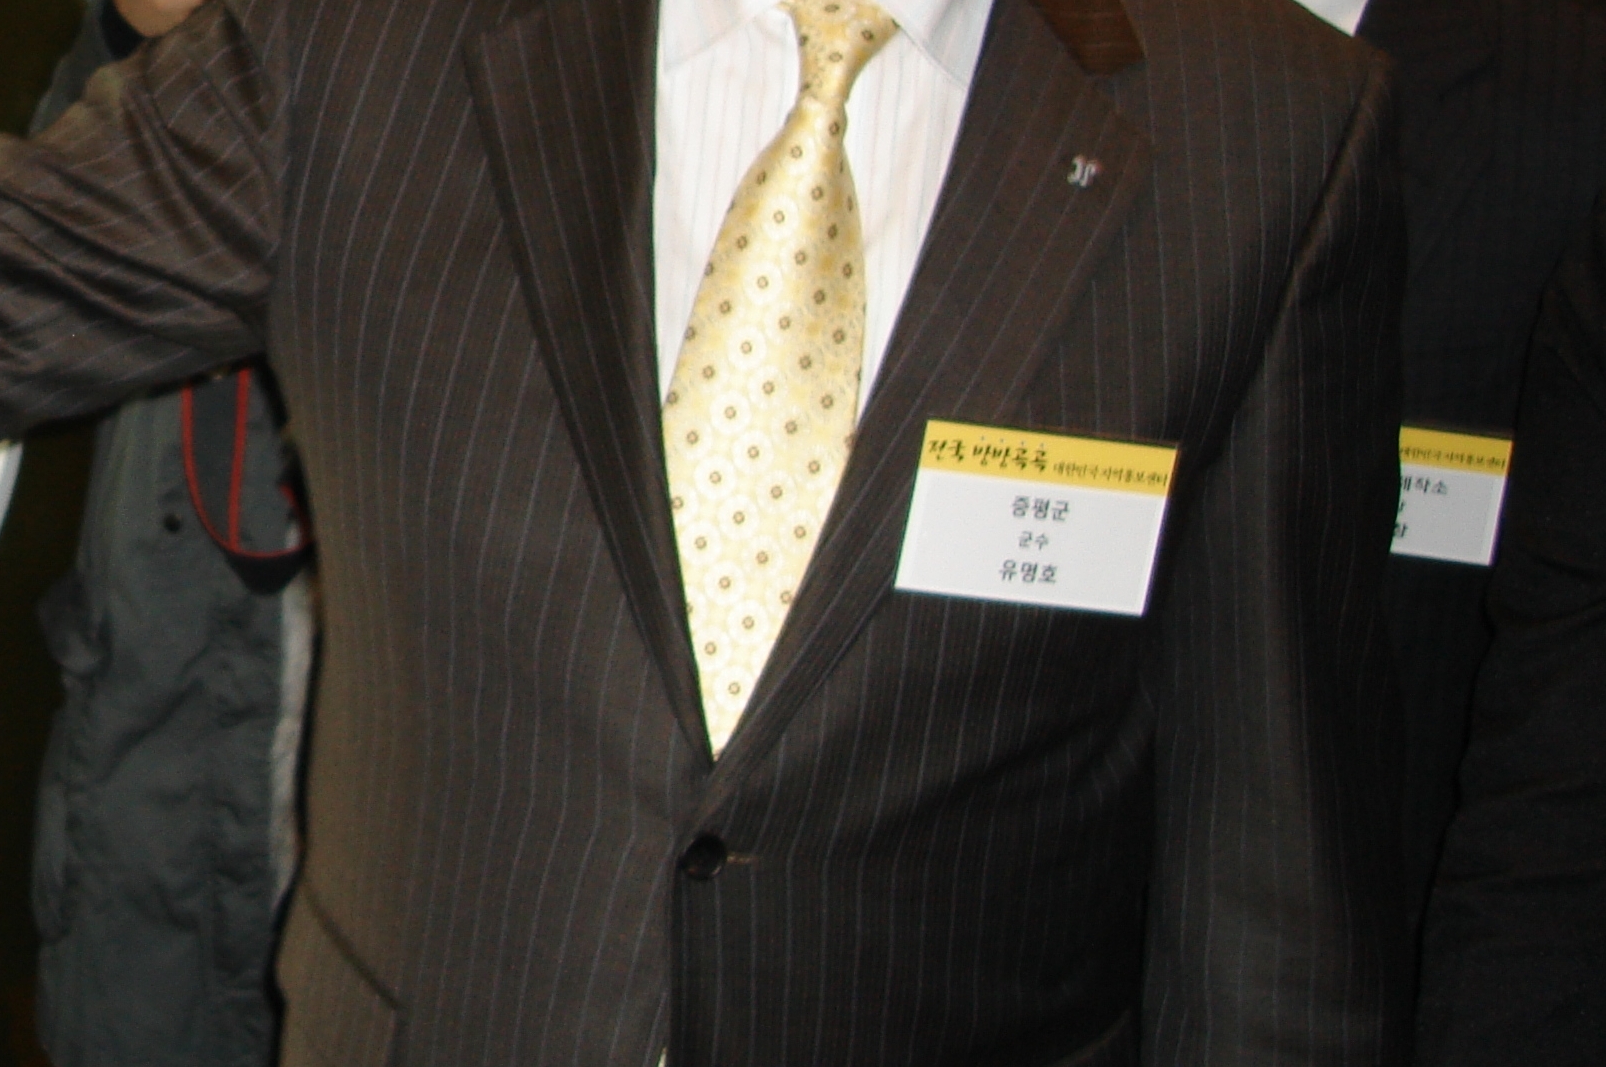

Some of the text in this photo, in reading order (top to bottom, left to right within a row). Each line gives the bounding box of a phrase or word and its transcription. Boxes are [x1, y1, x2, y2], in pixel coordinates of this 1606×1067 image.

[928, 439, 966, 462] 전국
[972, 442, 1048, 471] 방방곡곡
[1011, 495, 1070, 522] 증평군
[1018, 530, 1050, 551] 군수
[999, 559, 1058, 584] 유명호
